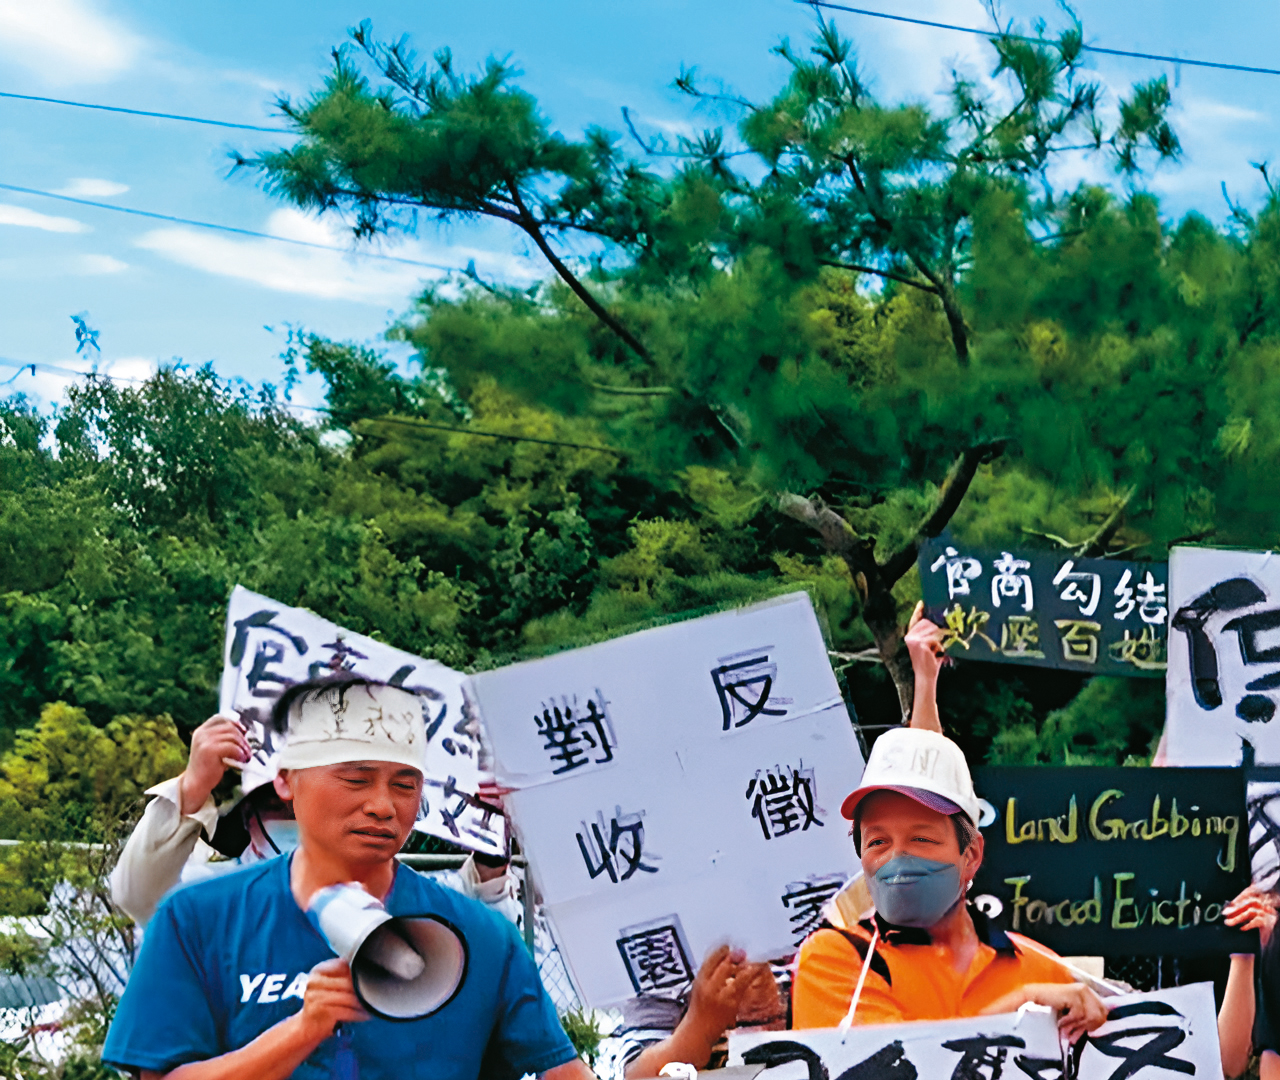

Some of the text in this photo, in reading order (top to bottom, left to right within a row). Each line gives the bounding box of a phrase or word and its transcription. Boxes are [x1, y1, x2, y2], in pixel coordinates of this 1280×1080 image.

[1006, 789, 1239, 873] Land Grabbing
[1004, 872, 1225, 930] Forced Evictio
